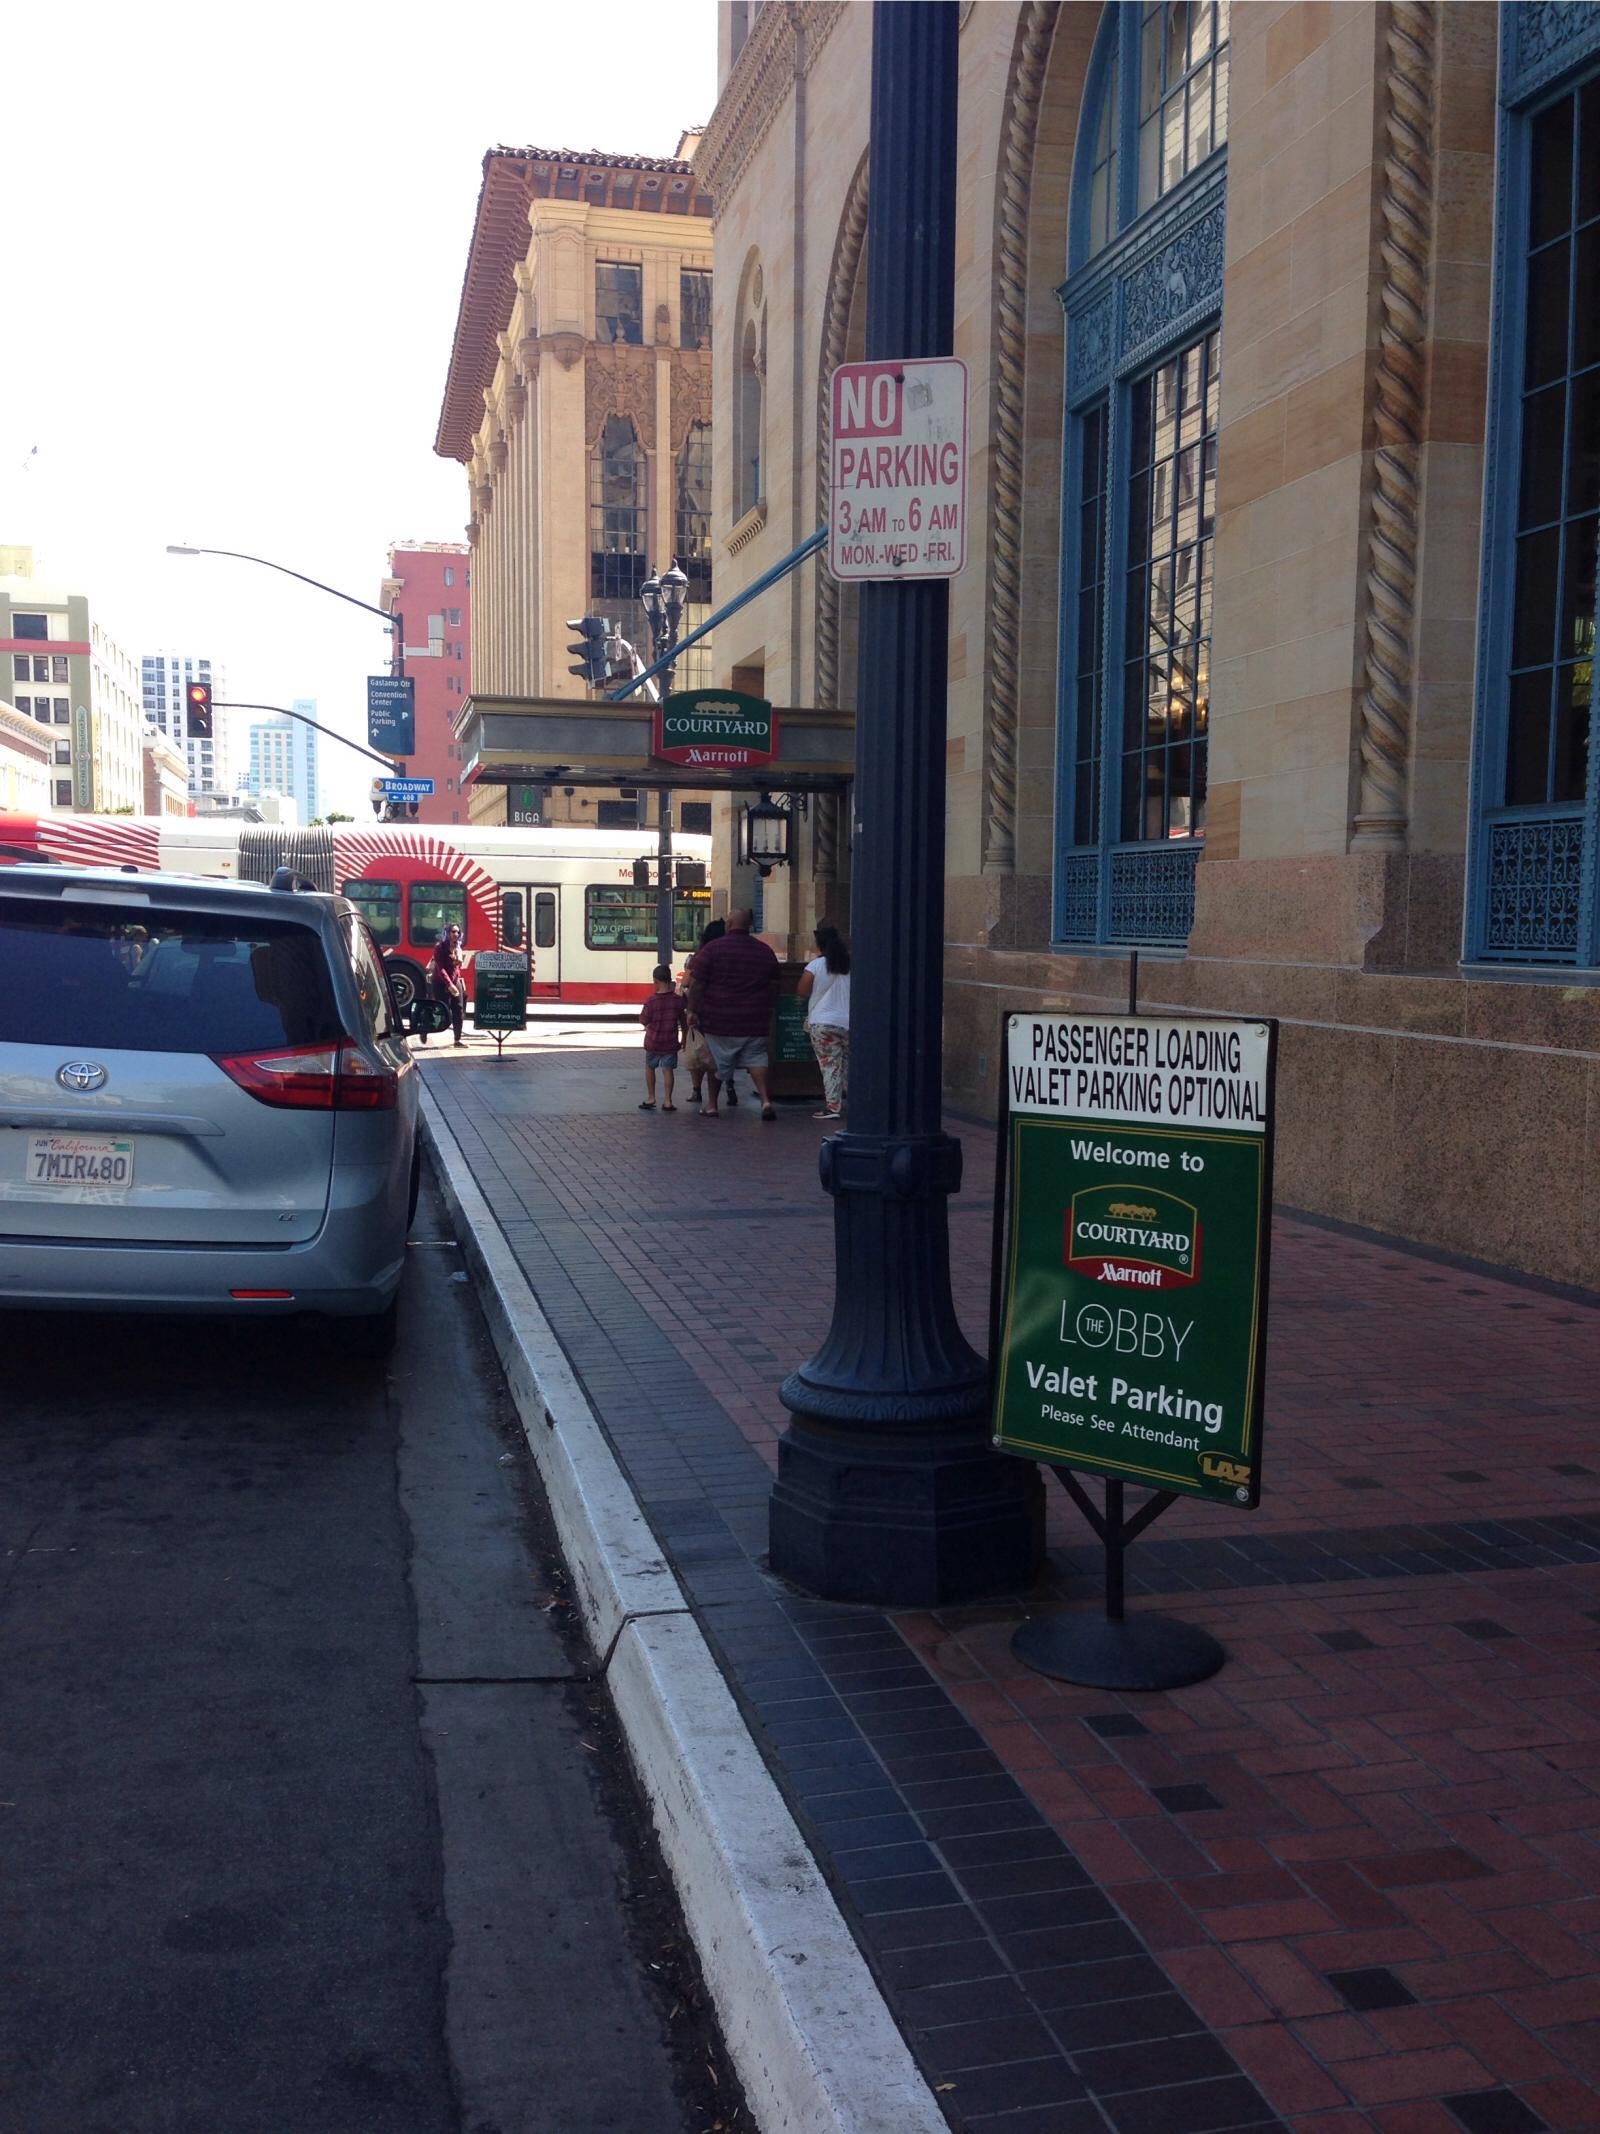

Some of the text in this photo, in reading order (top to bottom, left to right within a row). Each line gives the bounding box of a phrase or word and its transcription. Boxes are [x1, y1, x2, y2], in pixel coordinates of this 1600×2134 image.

[840, 373, 896, 430] NO
[839, 442, 959, 490] PARKING
[839, 497, 958, 534] 3 AM TO 6 AM
[370, 691, 407, 699] Convention
[371, 718, 396, 726] Parking
[665, 718, 769, 736] COURTYARD
[685, 749, 748, 763] Marriott
[385, 781, 431, 792] BROADWAY
[402, 793, 415, 801] 600
[514, 811, 540, 824] BIGA
[1032, 1024, 1241, 1073] PASSENGER LOADING
[1011, 1065, 1267, 1122] VALET PARKING OPTIONAL
[35, 1153, 126, 1180] 7MIR480
[1070, 1139, 1205, 1173] Welcome to
[1076, 1221, 1190, 1252] COURTYARD
[1097, 1262, 1163, 1287] Marriott
[1085, 1317, 1105, 1335] THE
[1025, 1360, 1224, 1434] Valet Parking
[1041, 1404, 1200, 1452] Please See Attendant
[1203, 1456, 1251, 1485] LAZ
